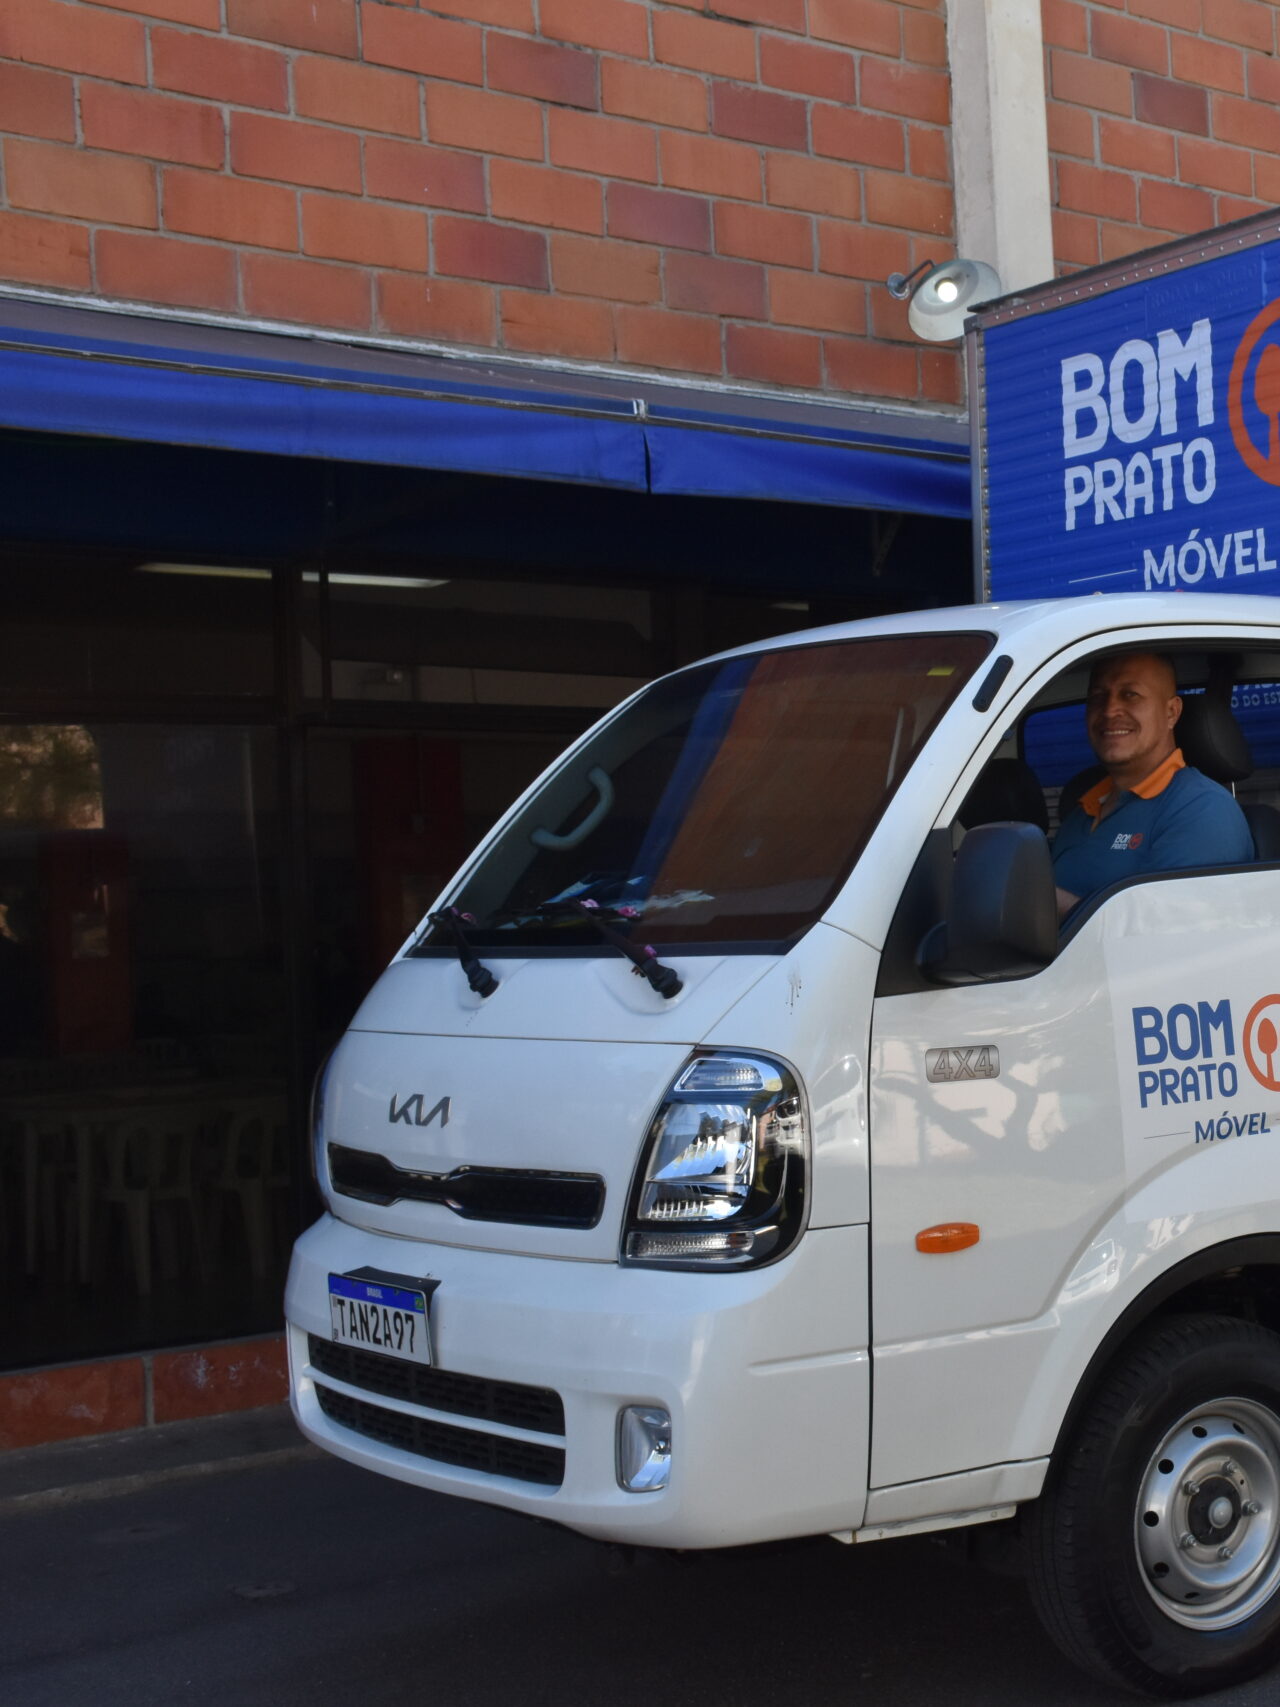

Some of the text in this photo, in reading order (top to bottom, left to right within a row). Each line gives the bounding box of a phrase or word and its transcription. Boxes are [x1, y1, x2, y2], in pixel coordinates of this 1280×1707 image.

[1060, 318, 1214, 459] BOM
[1064, 437, 1216, 531] PRATO
[1142, 528, 1277, 591] MÓVEL
[1243, 694, 1260, 707] DO
[1132, 999, 1235, 1066] BOM
[933, 1047, 994, 1080] 4X4
[1138, 1061, 1238, 1108] PRATO
[388, 1093, 452, 1128] KIA
[1194, 1110, 1271, 1144] MÓVEL
[336, 1298, 416, 1354] TAN2A97
